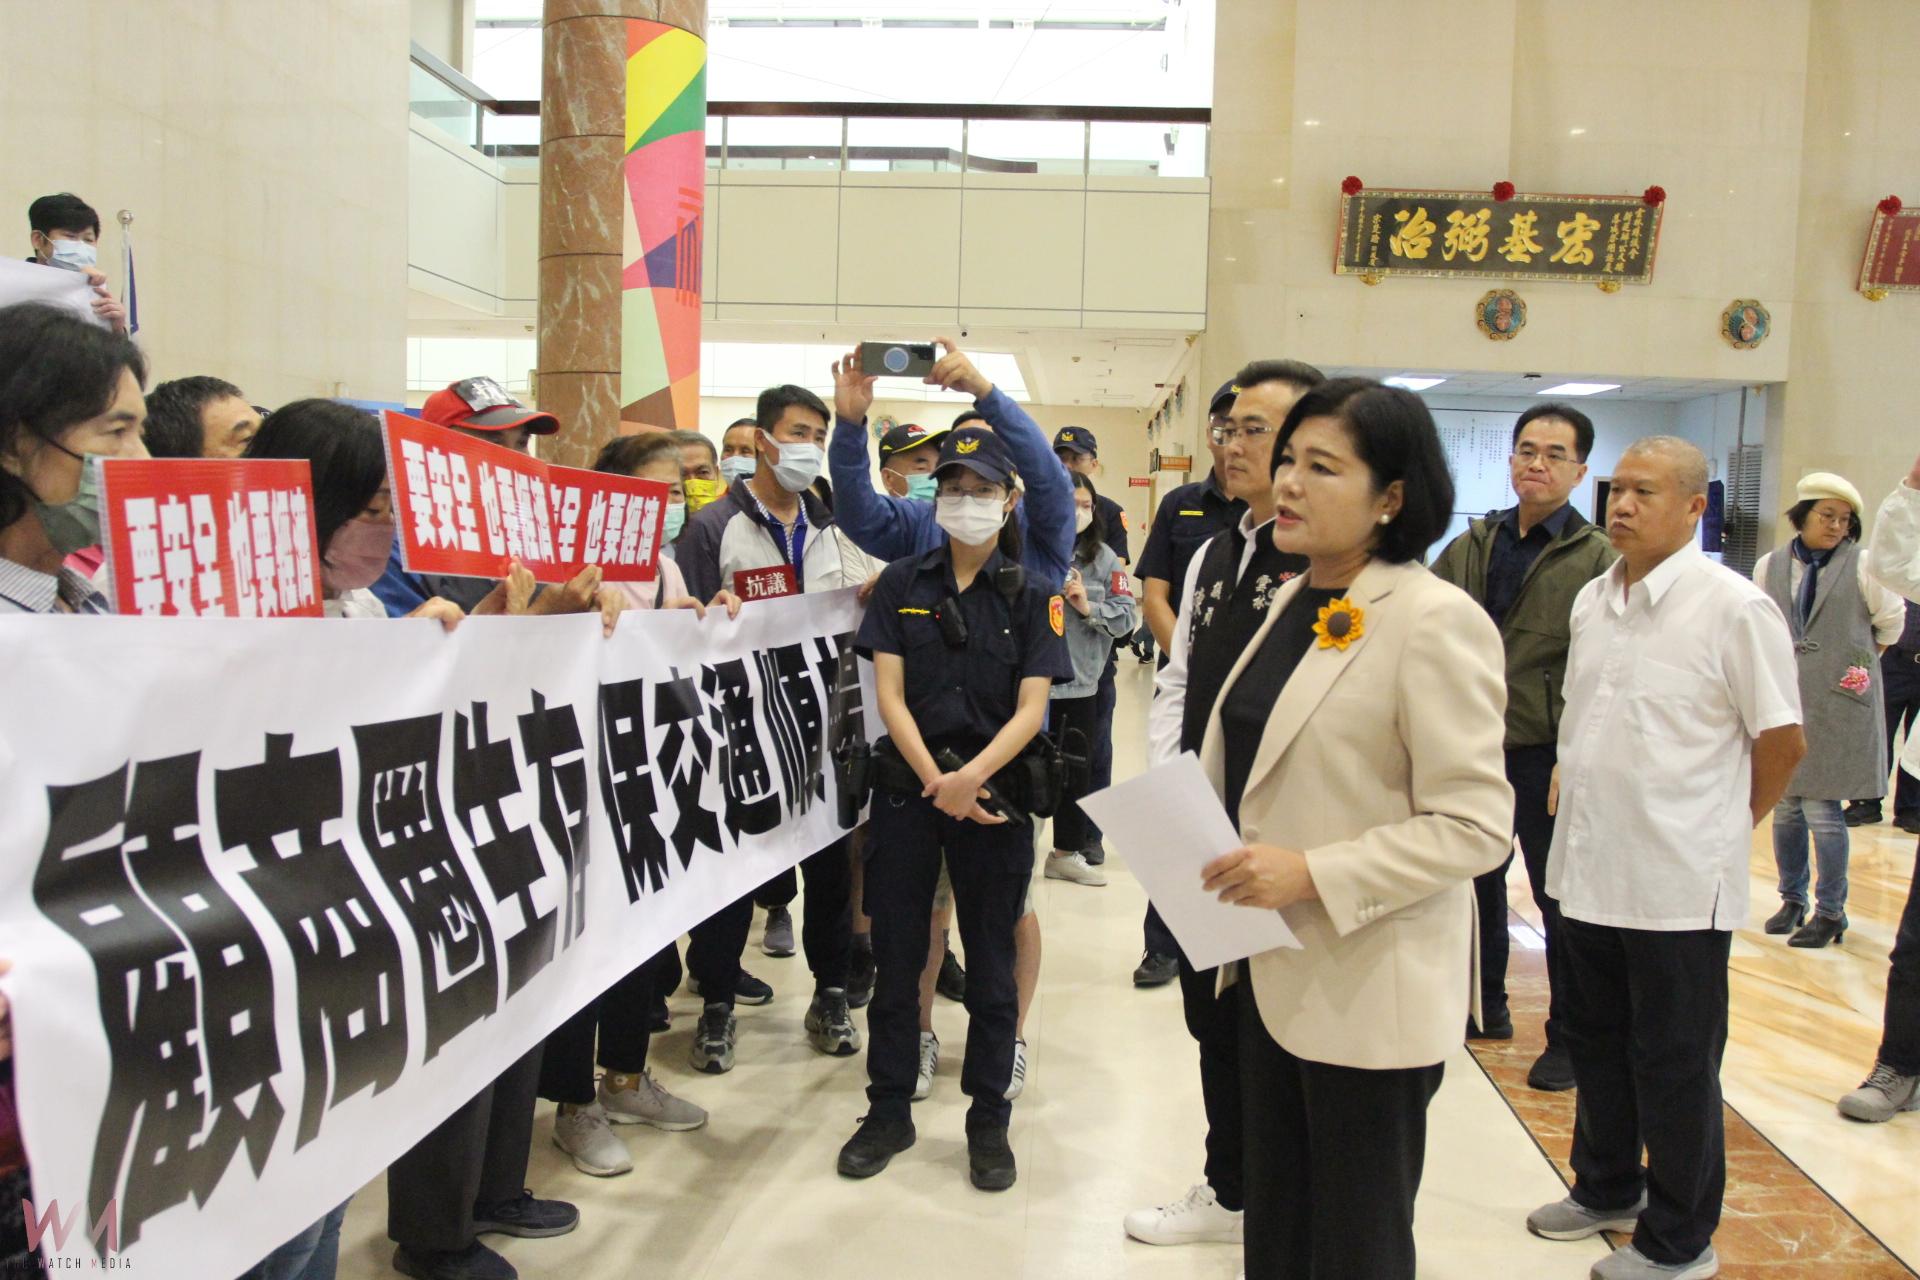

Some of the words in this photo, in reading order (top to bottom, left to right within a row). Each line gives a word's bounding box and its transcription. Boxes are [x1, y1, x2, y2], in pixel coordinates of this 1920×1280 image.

[124, 493, 226, 616] 要安全
[227, 485, 316, 616] 也要經濟
[401, 438, 481, 552] 要安全
[477, 460, 555, 564] 也要經濟
[583, 489, 660, 567] 也要經濟
[745, 571, 788, 598] 抗議
[33, 688, 590, 1254] 顧商圈生存
